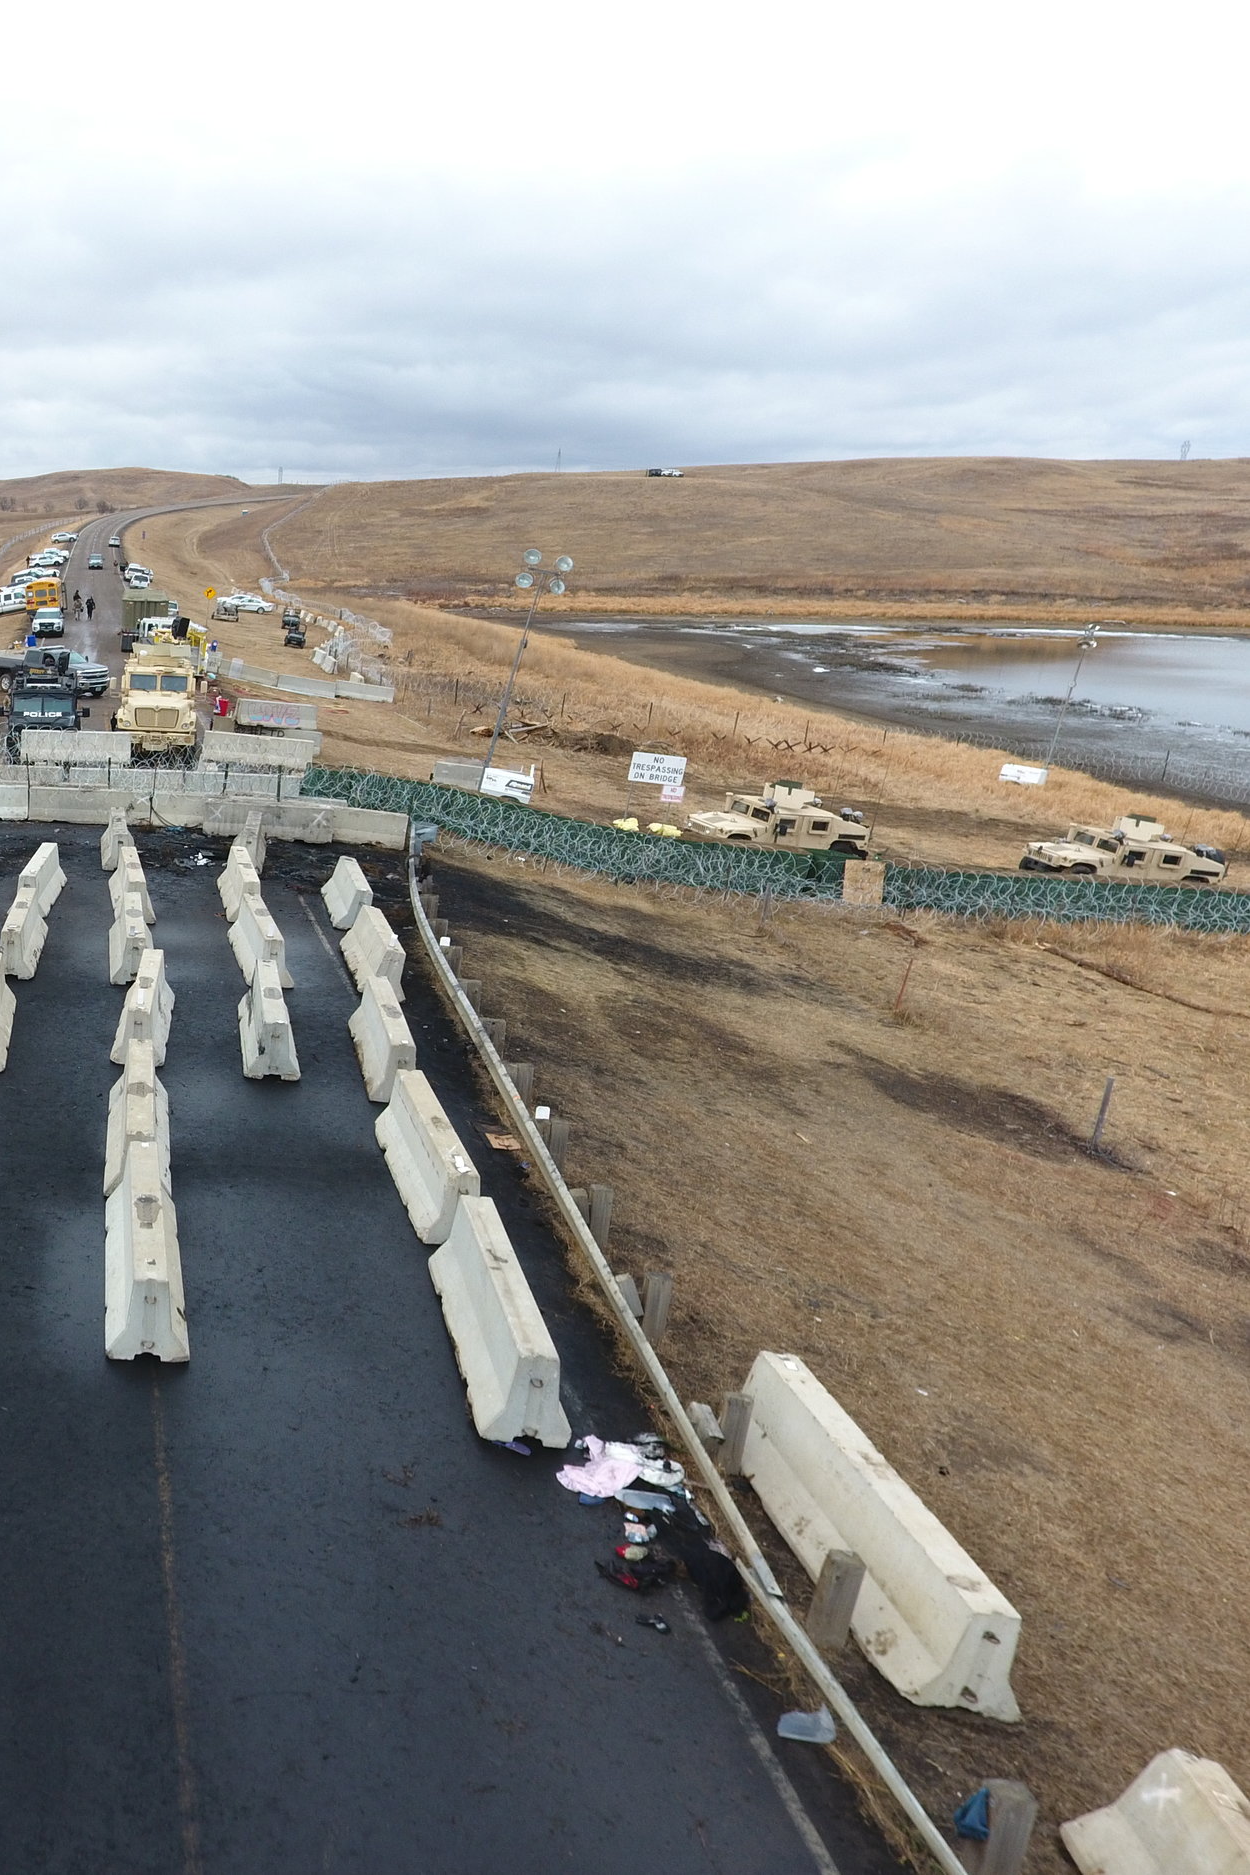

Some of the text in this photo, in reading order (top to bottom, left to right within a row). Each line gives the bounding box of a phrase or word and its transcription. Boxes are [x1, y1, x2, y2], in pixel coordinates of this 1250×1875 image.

[248, 702, 300, 725] LOVE
[653, 756, 665, 764] NO
[632, 763, 683, 775] TRESPASSING
[649, 773, 678, 783] BRIDGE
